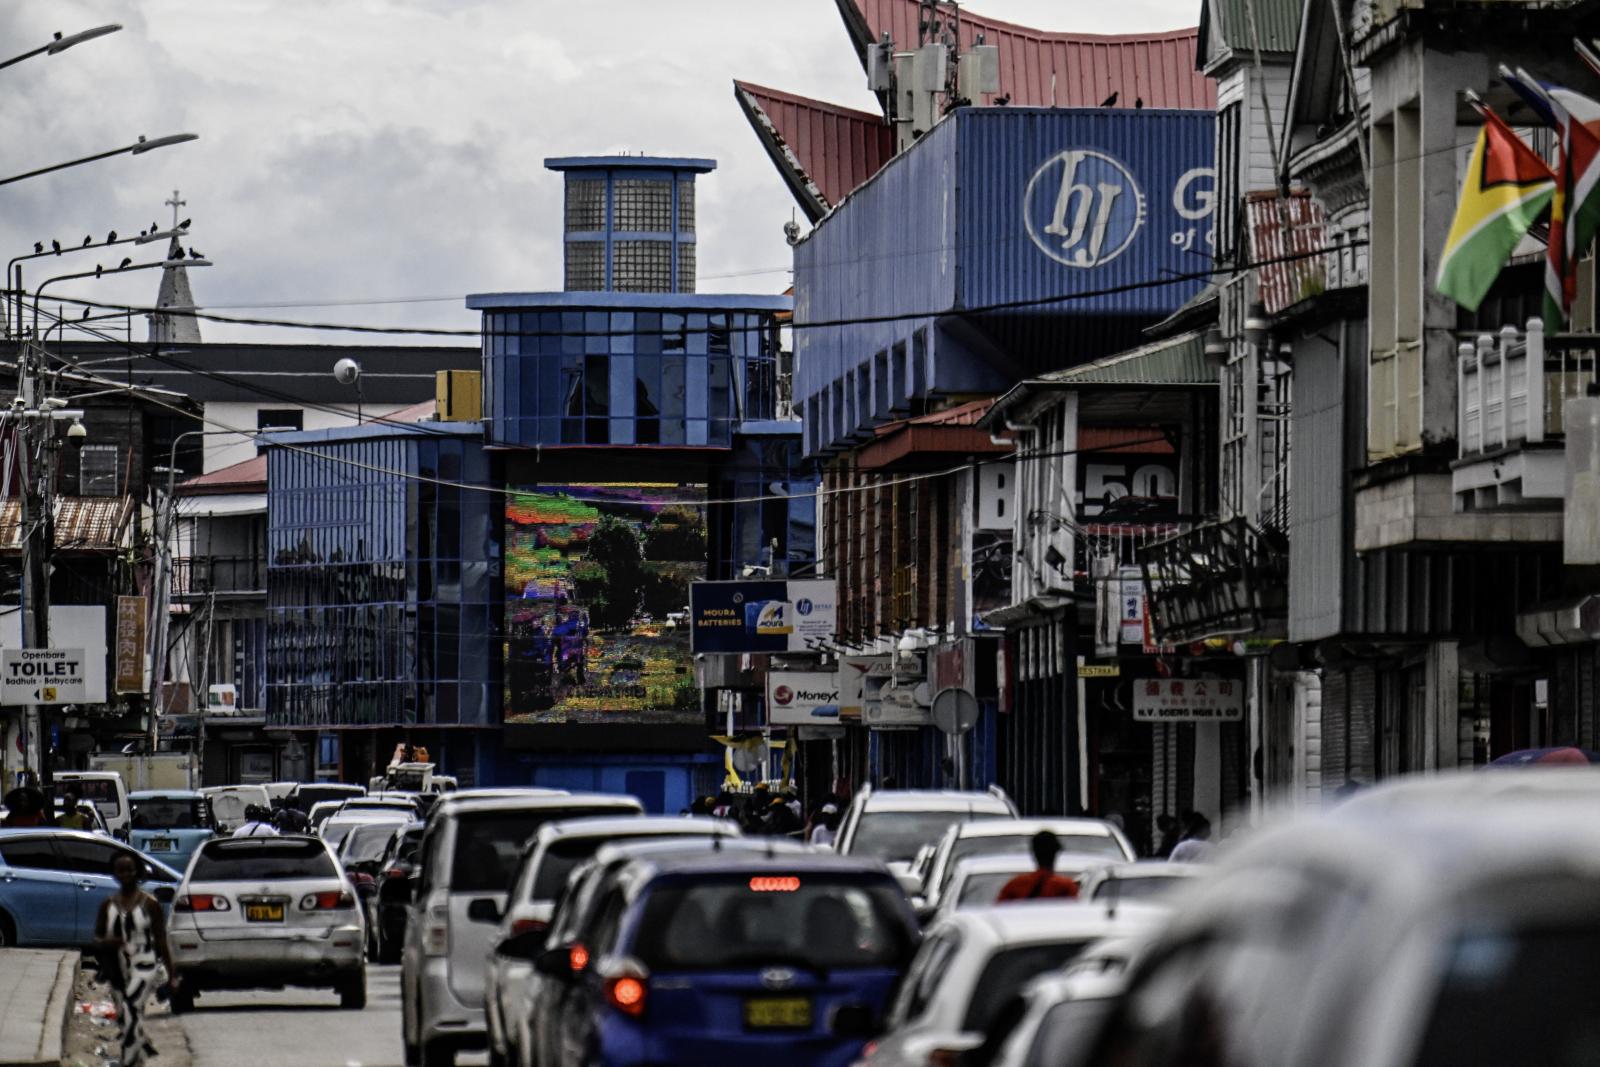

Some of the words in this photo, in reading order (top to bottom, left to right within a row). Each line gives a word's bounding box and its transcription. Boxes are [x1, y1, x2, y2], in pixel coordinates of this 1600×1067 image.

[1171, 229, 1196, 251] of
[703, 609, 736, 617] MOURA
[697, 619, 743, 627] BATTERIES
[21, 651, 66, 660] Openbare
[9, 661, 79, 676] TOILET
[5, 677, 37, 686] Badhuis
[44, 677, 83, 686] Babycare
